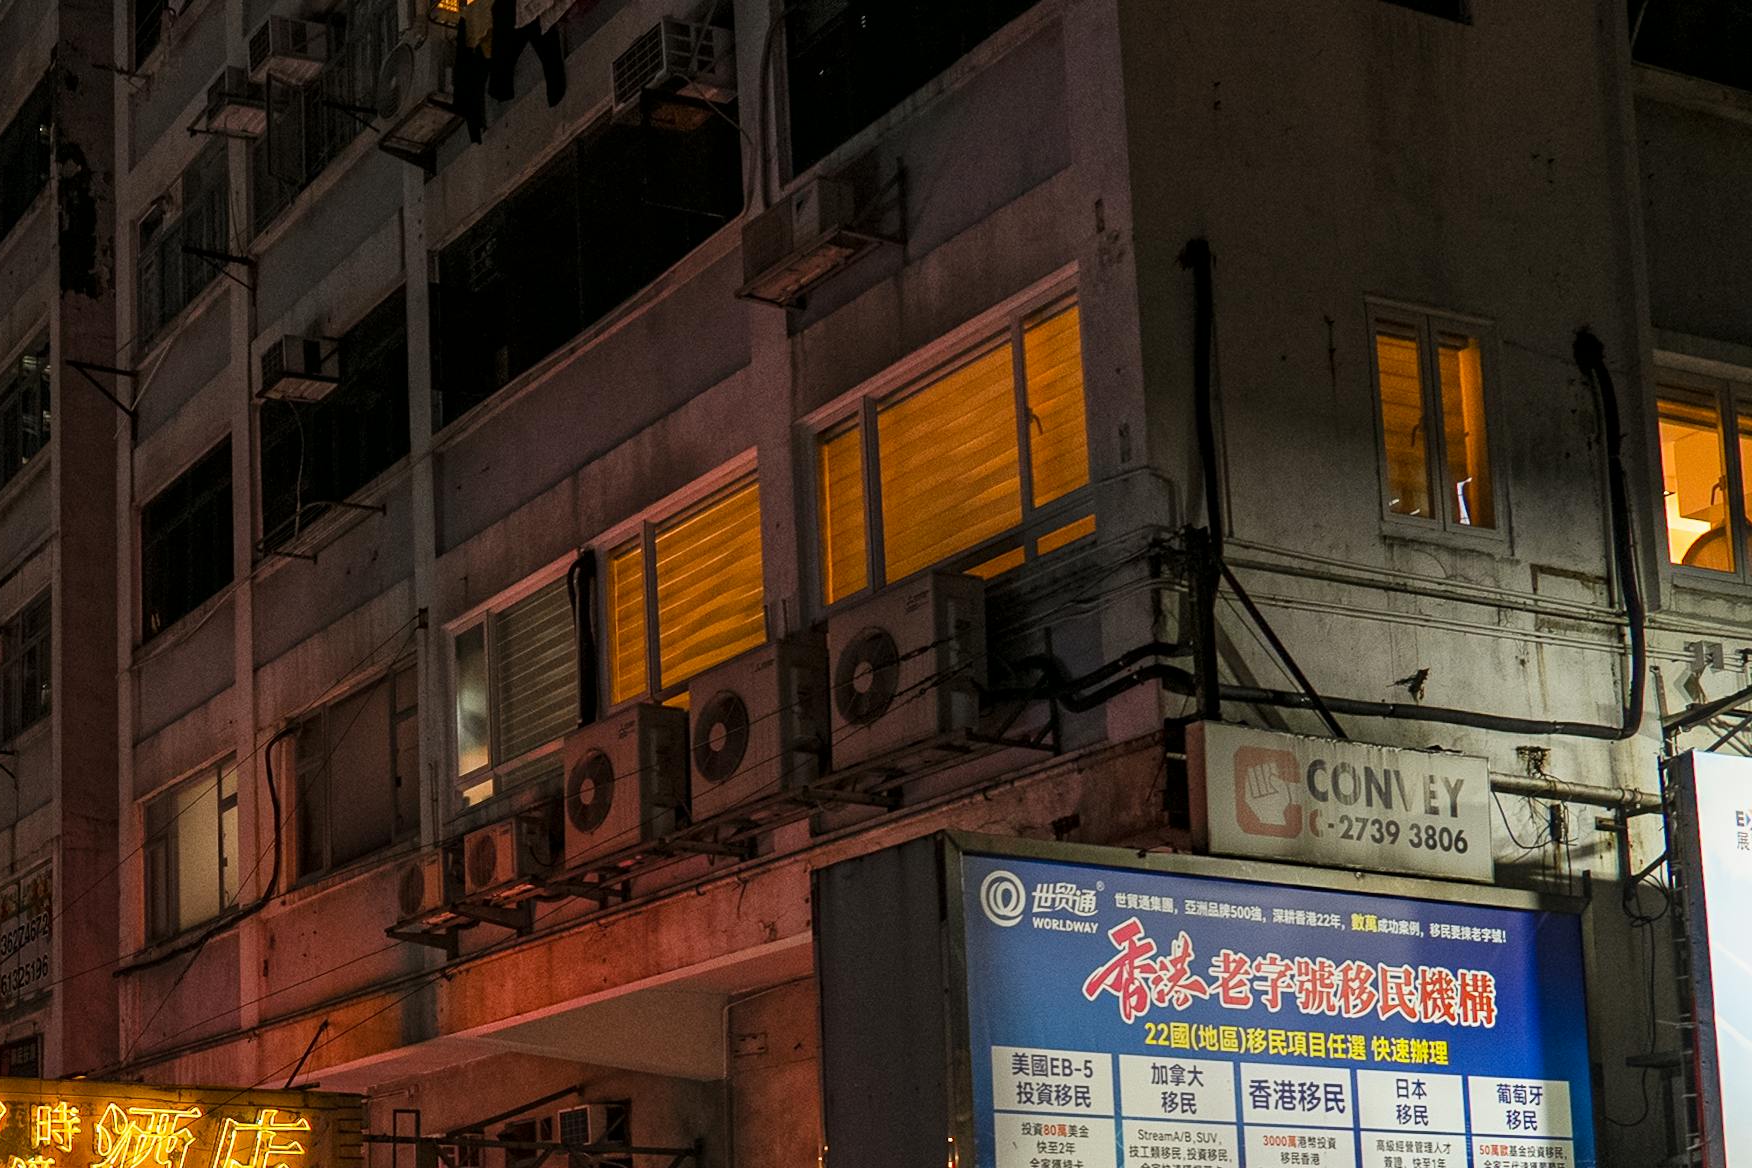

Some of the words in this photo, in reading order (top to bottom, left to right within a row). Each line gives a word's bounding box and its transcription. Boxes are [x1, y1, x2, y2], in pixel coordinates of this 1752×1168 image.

[1408, 823, 1469, 855] 3806
[1032, 882, 1098, 917] 世贸通
[1032, 916, 1098, 934] WORLDWAY
[1082, 916, 1497, 1028] 香港老字號移民機構
[1144, 1022, 1366, 1060] 22國(地區)移民項目任選
[1371, 1035, 1449, 1065] 快速辦理
[1011, 1052, 1093, 1078] 美國EB-5
[1151, 1062, 1204, 1087] 加拿大
[1016, 1082, 1092, 1108] 投資移民
[1248, 1078, 1346, 1114] 香港移民
[1396, 1078, 1427, 1100] 日本
[1496, 1083, 1543, 1106] 葡萄牙
[1161, 1091, 1198, 1115] 移民
[1396, 1104, 1429, 1126] 移民
[1506, 1109, 1538, 1131] 移民
[1021, 1122, 1089, 1138] 投資80萬美金
[1036, 1140, 1076, 1155] 快至2年
[1262, 1135, 1337, 1150] 3000萬港幣投資
[1280, 1151, 1321, 1166] 移民香港
